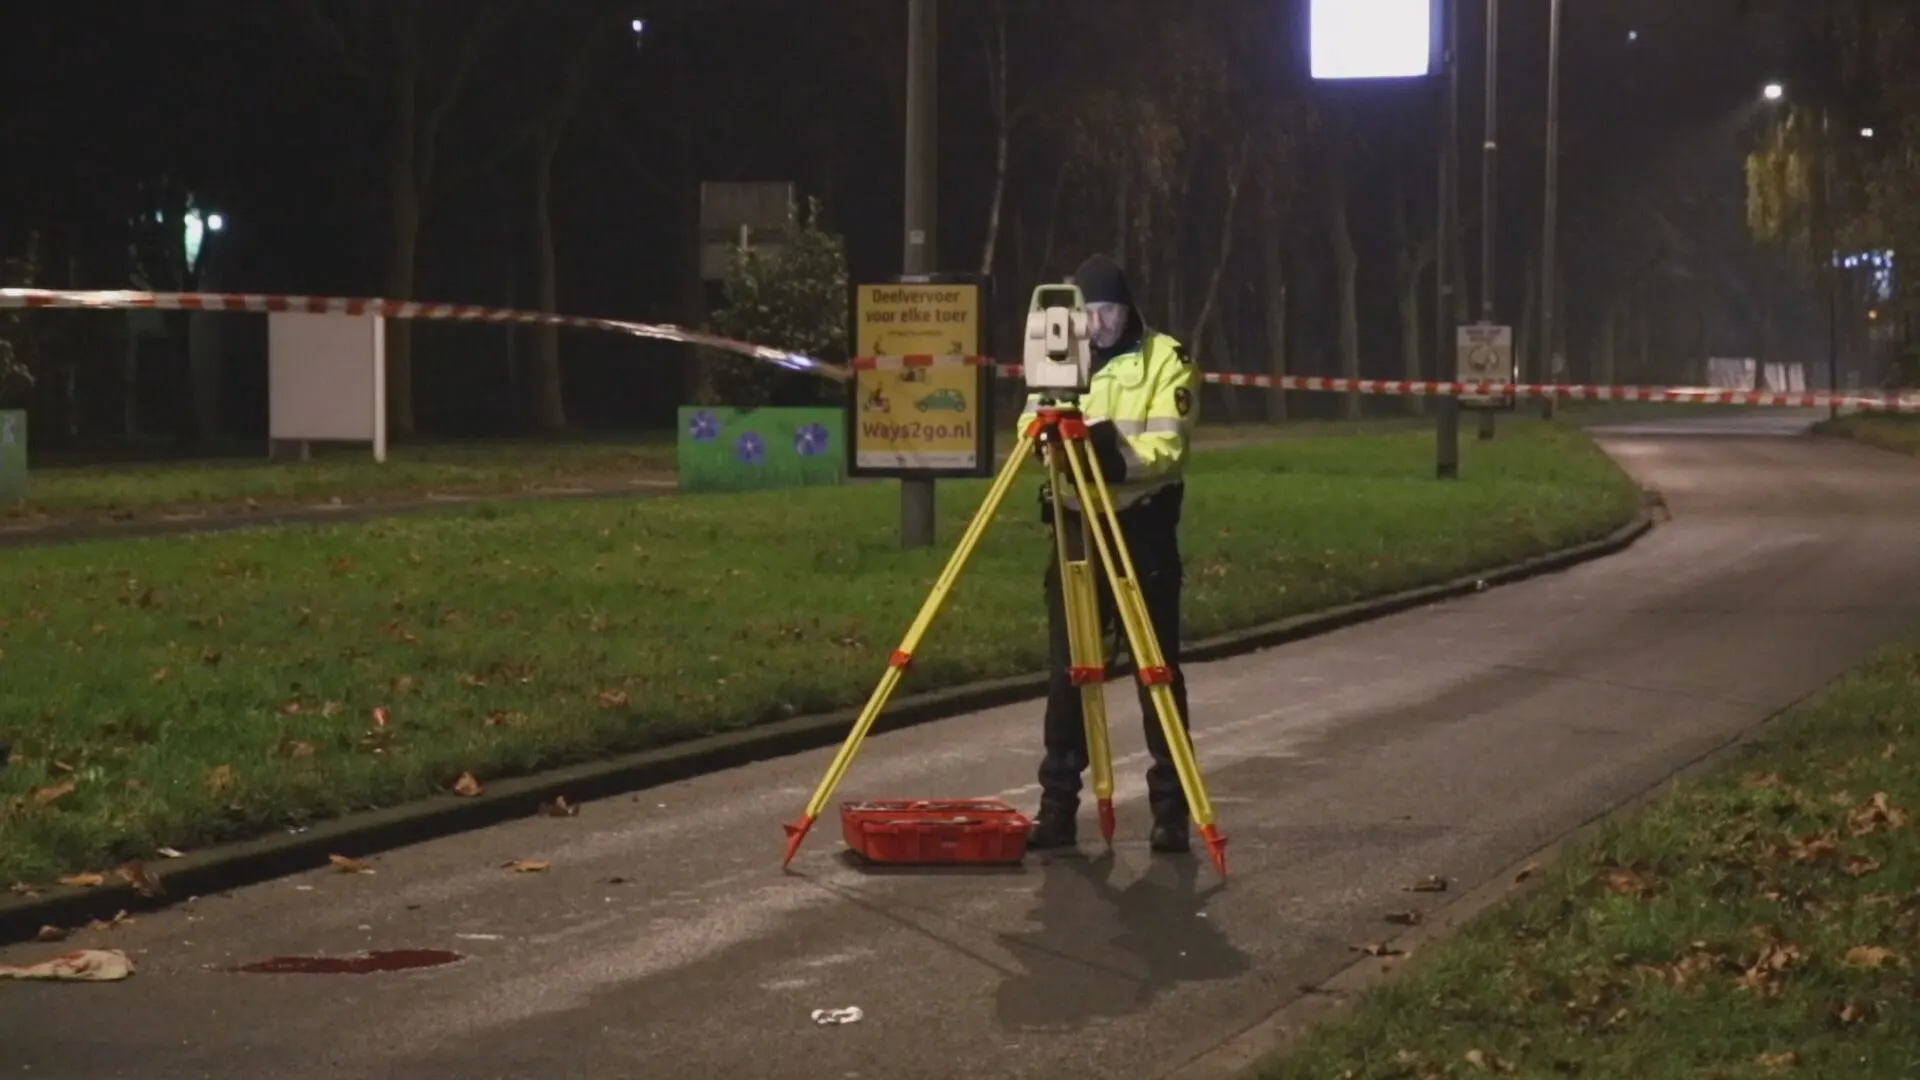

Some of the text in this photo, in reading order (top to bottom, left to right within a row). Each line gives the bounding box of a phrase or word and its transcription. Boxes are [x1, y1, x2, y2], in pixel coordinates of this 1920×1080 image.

[872, 289, 960, 303] Deelvervoer
[865, 308, 968, 323] voor elke toer
[863, 422, 971, 441] Ways2go.nl
